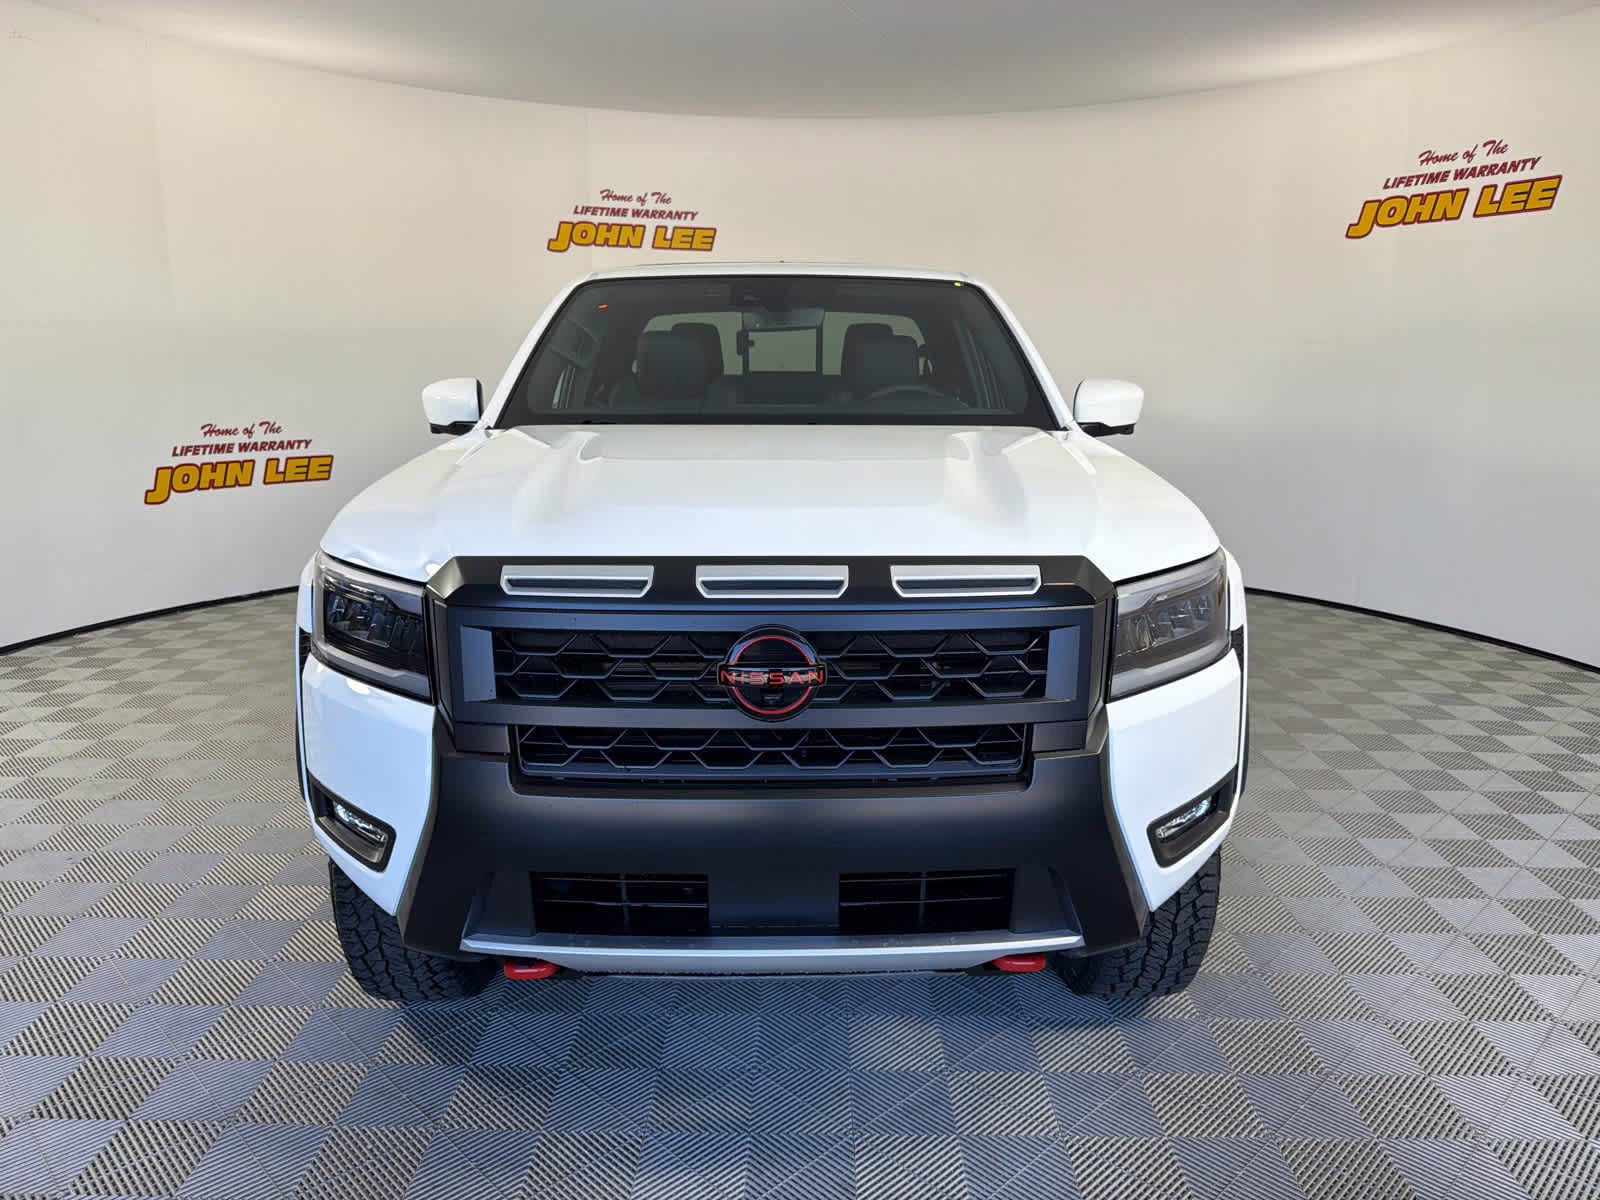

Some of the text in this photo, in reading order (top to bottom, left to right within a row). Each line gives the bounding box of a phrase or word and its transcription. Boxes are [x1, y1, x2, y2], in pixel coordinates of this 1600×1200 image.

[1418, 139, 1509, 166] Home of The
[1383, 156, 1542, 190] LIFETIME WARRANTY
[600, 189, 672, 206] Home of The
[1345, 174, 1563, 239] JOHN LEE
[574, 205, 698, 221] LIFETIME WARRANTY
[547, 221, 717, 253] JOHN LEE
[201, 421, 282, 439] Home of The
[172, 439, 312, 457] LIFETIME WARRANTY
[144, 455, 334, 505] JOHN LEE
[721, 670, 824, 685] NISSAN
